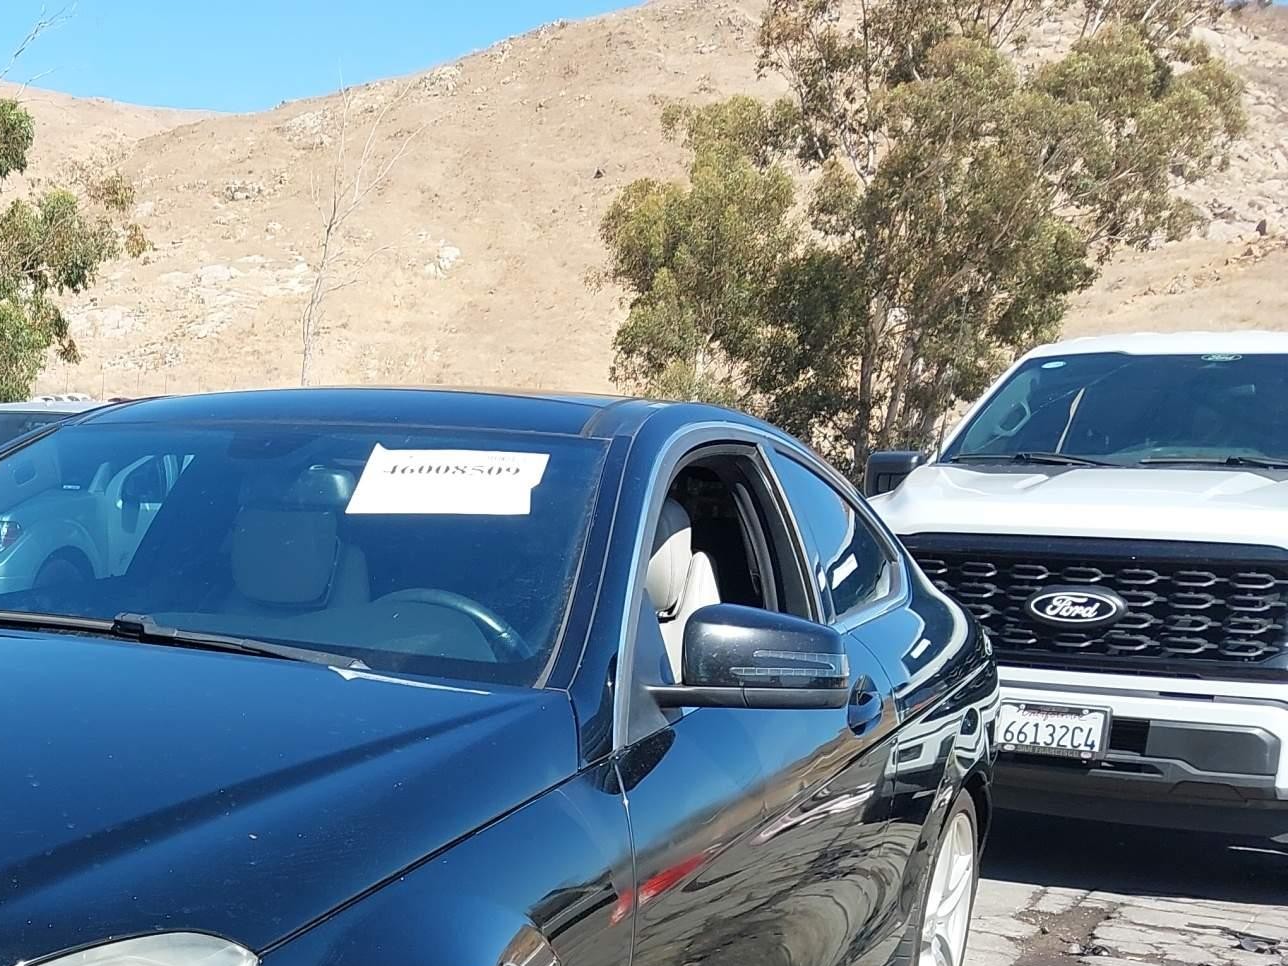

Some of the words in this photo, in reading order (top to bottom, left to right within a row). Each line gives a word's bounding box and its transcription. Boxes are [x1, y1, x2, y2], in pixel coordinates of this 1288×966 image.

[383, 464, 521, 476] 46008509
[1046, 595, 1101, 617] Ford
[1003, 720, 1096, 750] 66132C4
